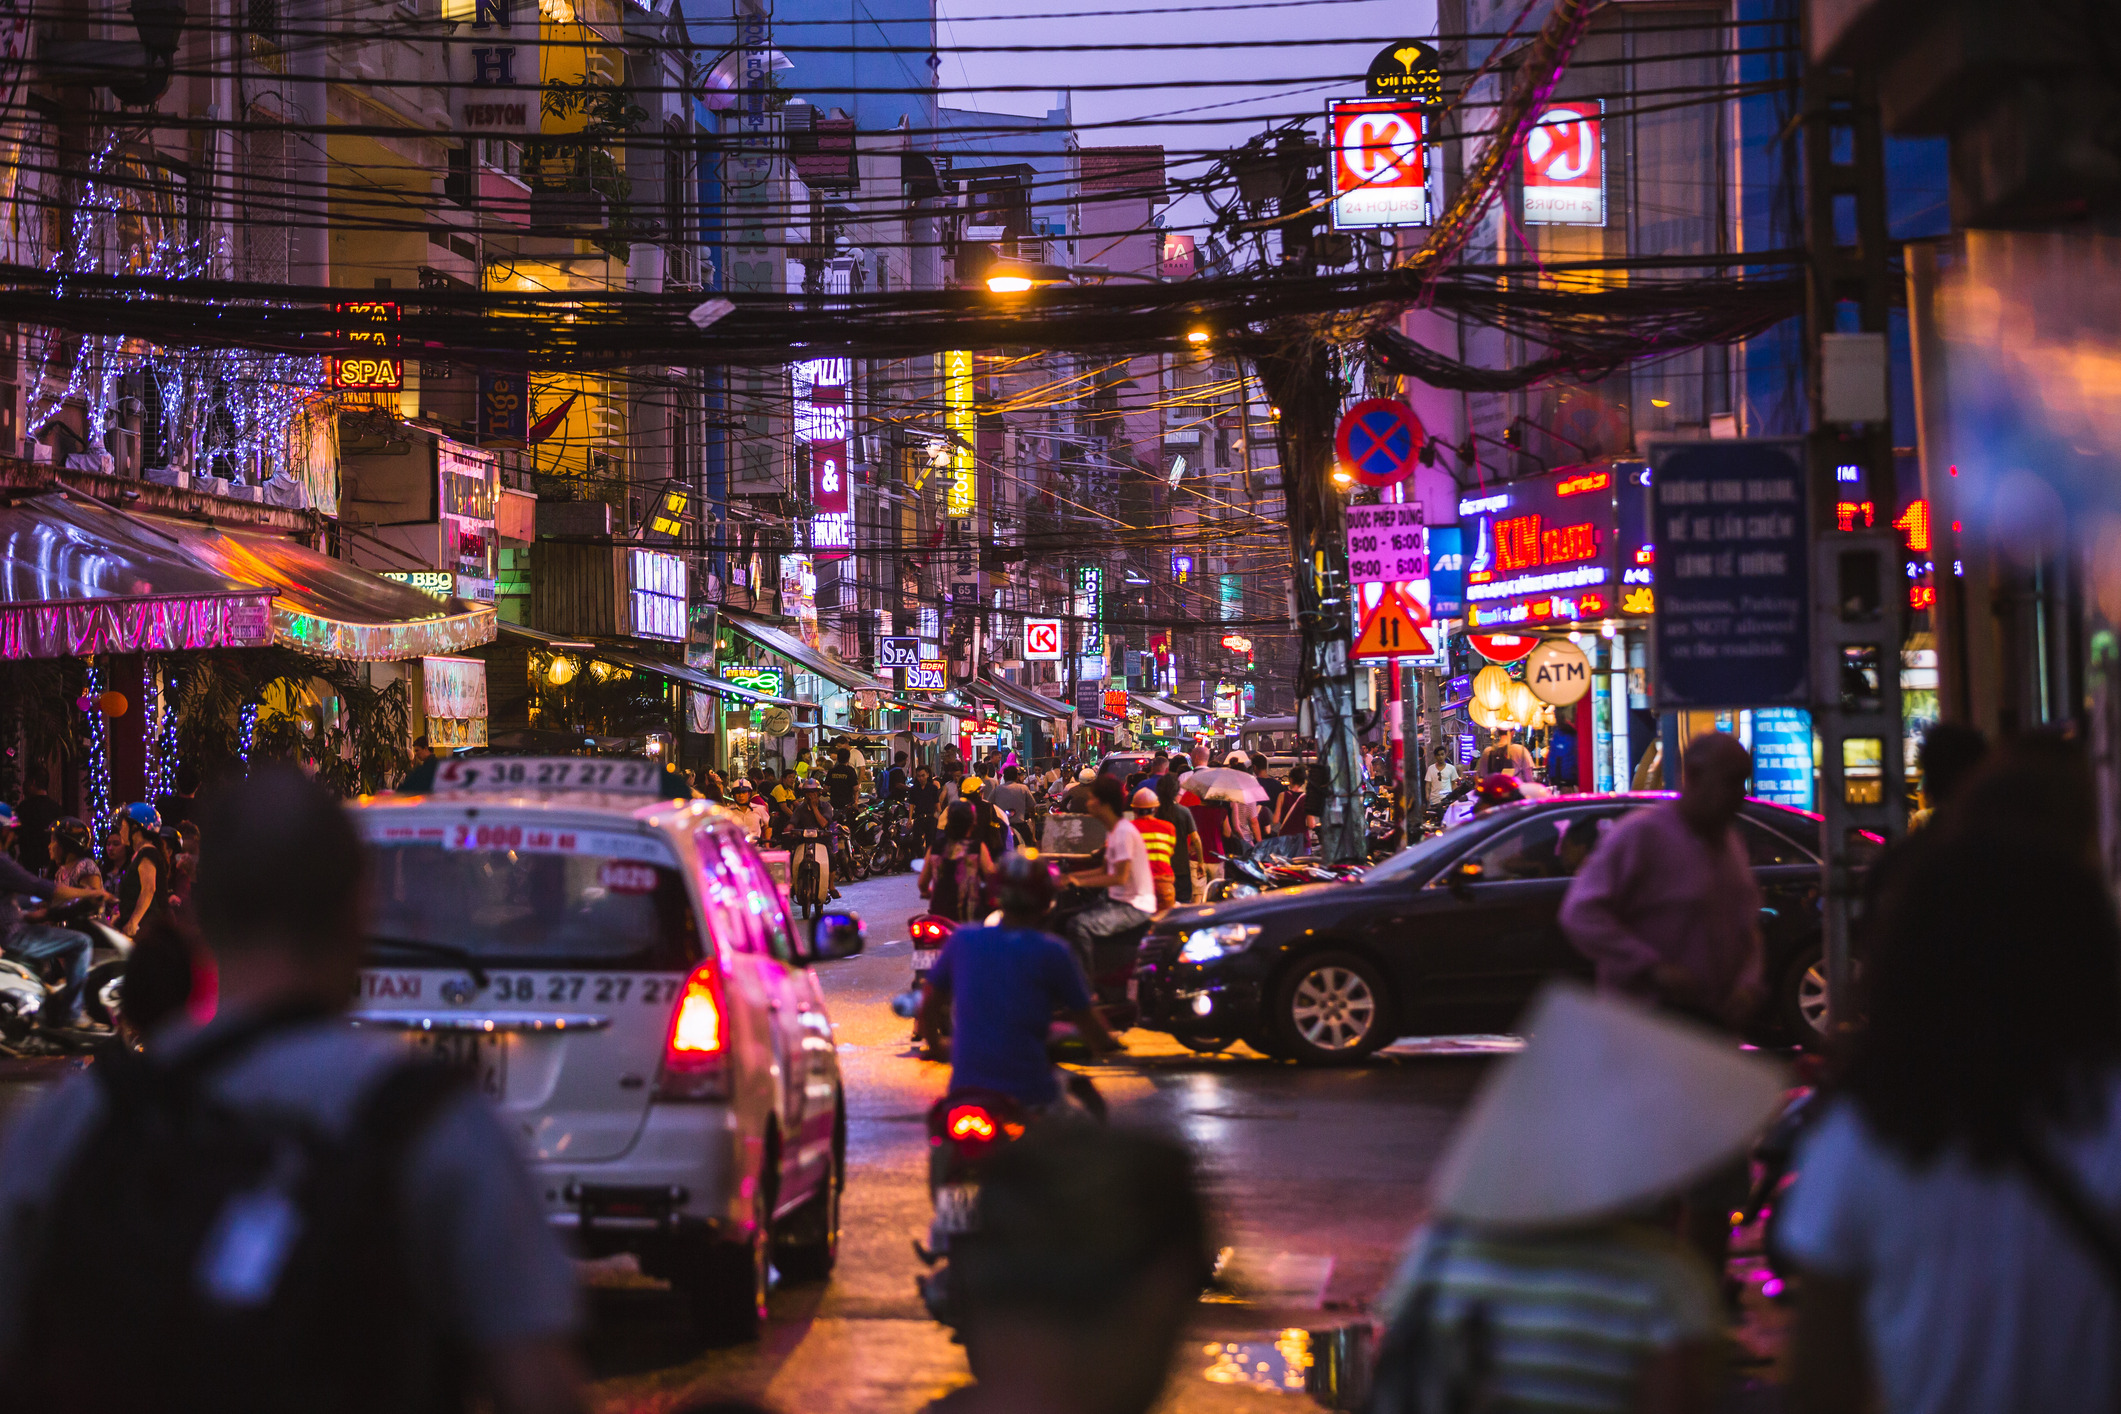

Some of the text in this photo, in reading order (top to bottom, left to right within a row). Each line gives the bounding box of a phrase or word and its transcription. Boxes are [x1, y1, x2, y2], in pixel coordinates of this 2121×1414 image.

[464, 104, 527, 127] VESTON
[1345, 200, 1418, 214] 24 HOURS
[341, 360, 396, 383] SPA
[811, 357, 845, 386] PIZZA
[487, 380, 518, 434] Tige
[812, 406, 845, 440] RIBS
[822, 459, 839, 492] &
[814, 513, 848, 546] MORE
[1351, 536, 1377, 552] 9:00
[1391, 533, 1420, 550] 16:00
[1351, 560, 1381, 576] 19:00
[1397, 558, 1422, 574] 6:00
[411, 572, 453, 590] BBQ
[958, 585, 971, 595] 65
[1085, 571, 1097, 618] HOTE
[884, 640, 918, 663] SPA
[907, 666, 944, 688] SPA
[1536, 663, 1585, 683] ATM
[368, 974, 422, 999] TAXI
[594, 977, 632, 1002] 27
